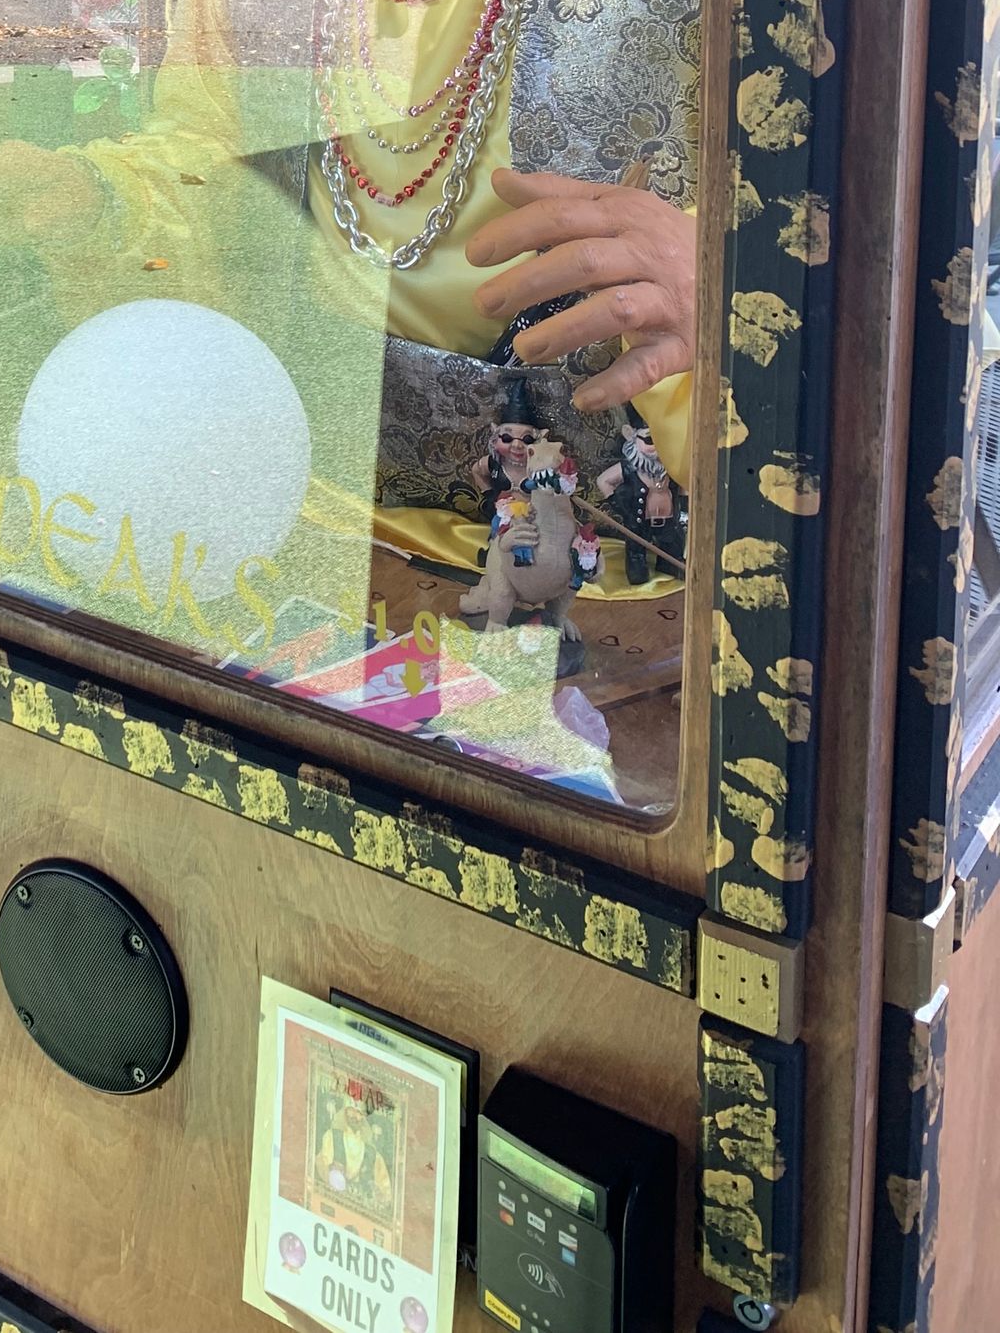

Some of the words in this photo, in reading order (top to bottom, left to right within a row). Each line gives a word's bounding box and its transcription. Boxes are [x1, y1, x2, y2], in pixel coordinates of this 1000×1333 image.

[336, 587, 474, 664] $1.00
[313, 1222, 396, 1294] CARDS
[320, 1274, 382, 1333] ONLY
